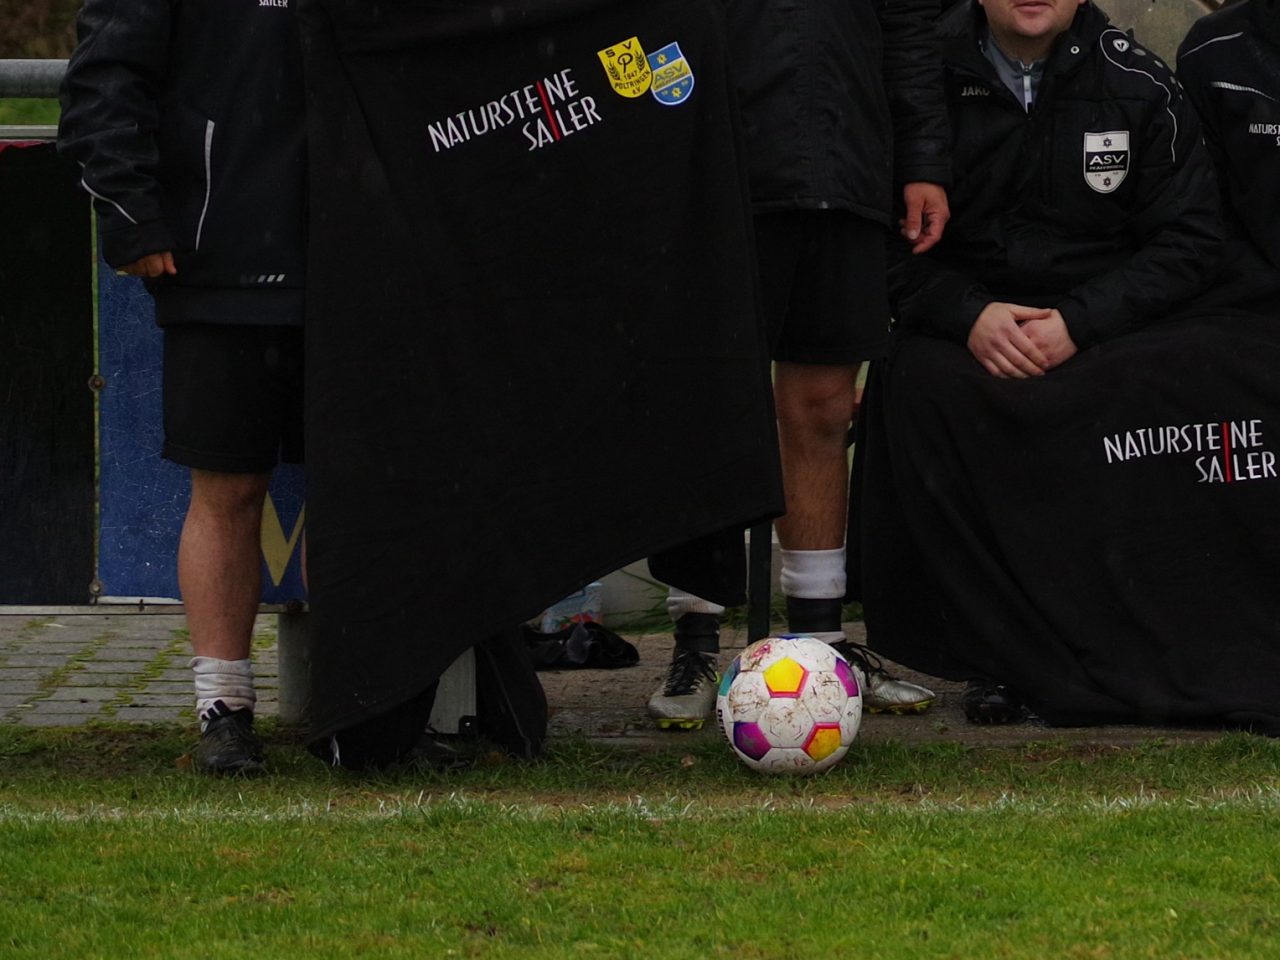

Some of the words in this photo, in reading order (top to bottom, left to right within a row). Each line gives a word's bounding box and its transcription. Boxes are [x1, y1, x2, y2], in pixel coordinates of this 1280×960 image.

[961, 85, 990, 96] JAKO
[428, 68, 579, 153] NATURSTEINE
[522, 90, 602, 152] SAILER
[1090, 154, 1125, 165] ASV
[1103, 419, 1263, 464] NATURSTEINE
[1195, 449, 1277, 483] SAILER
